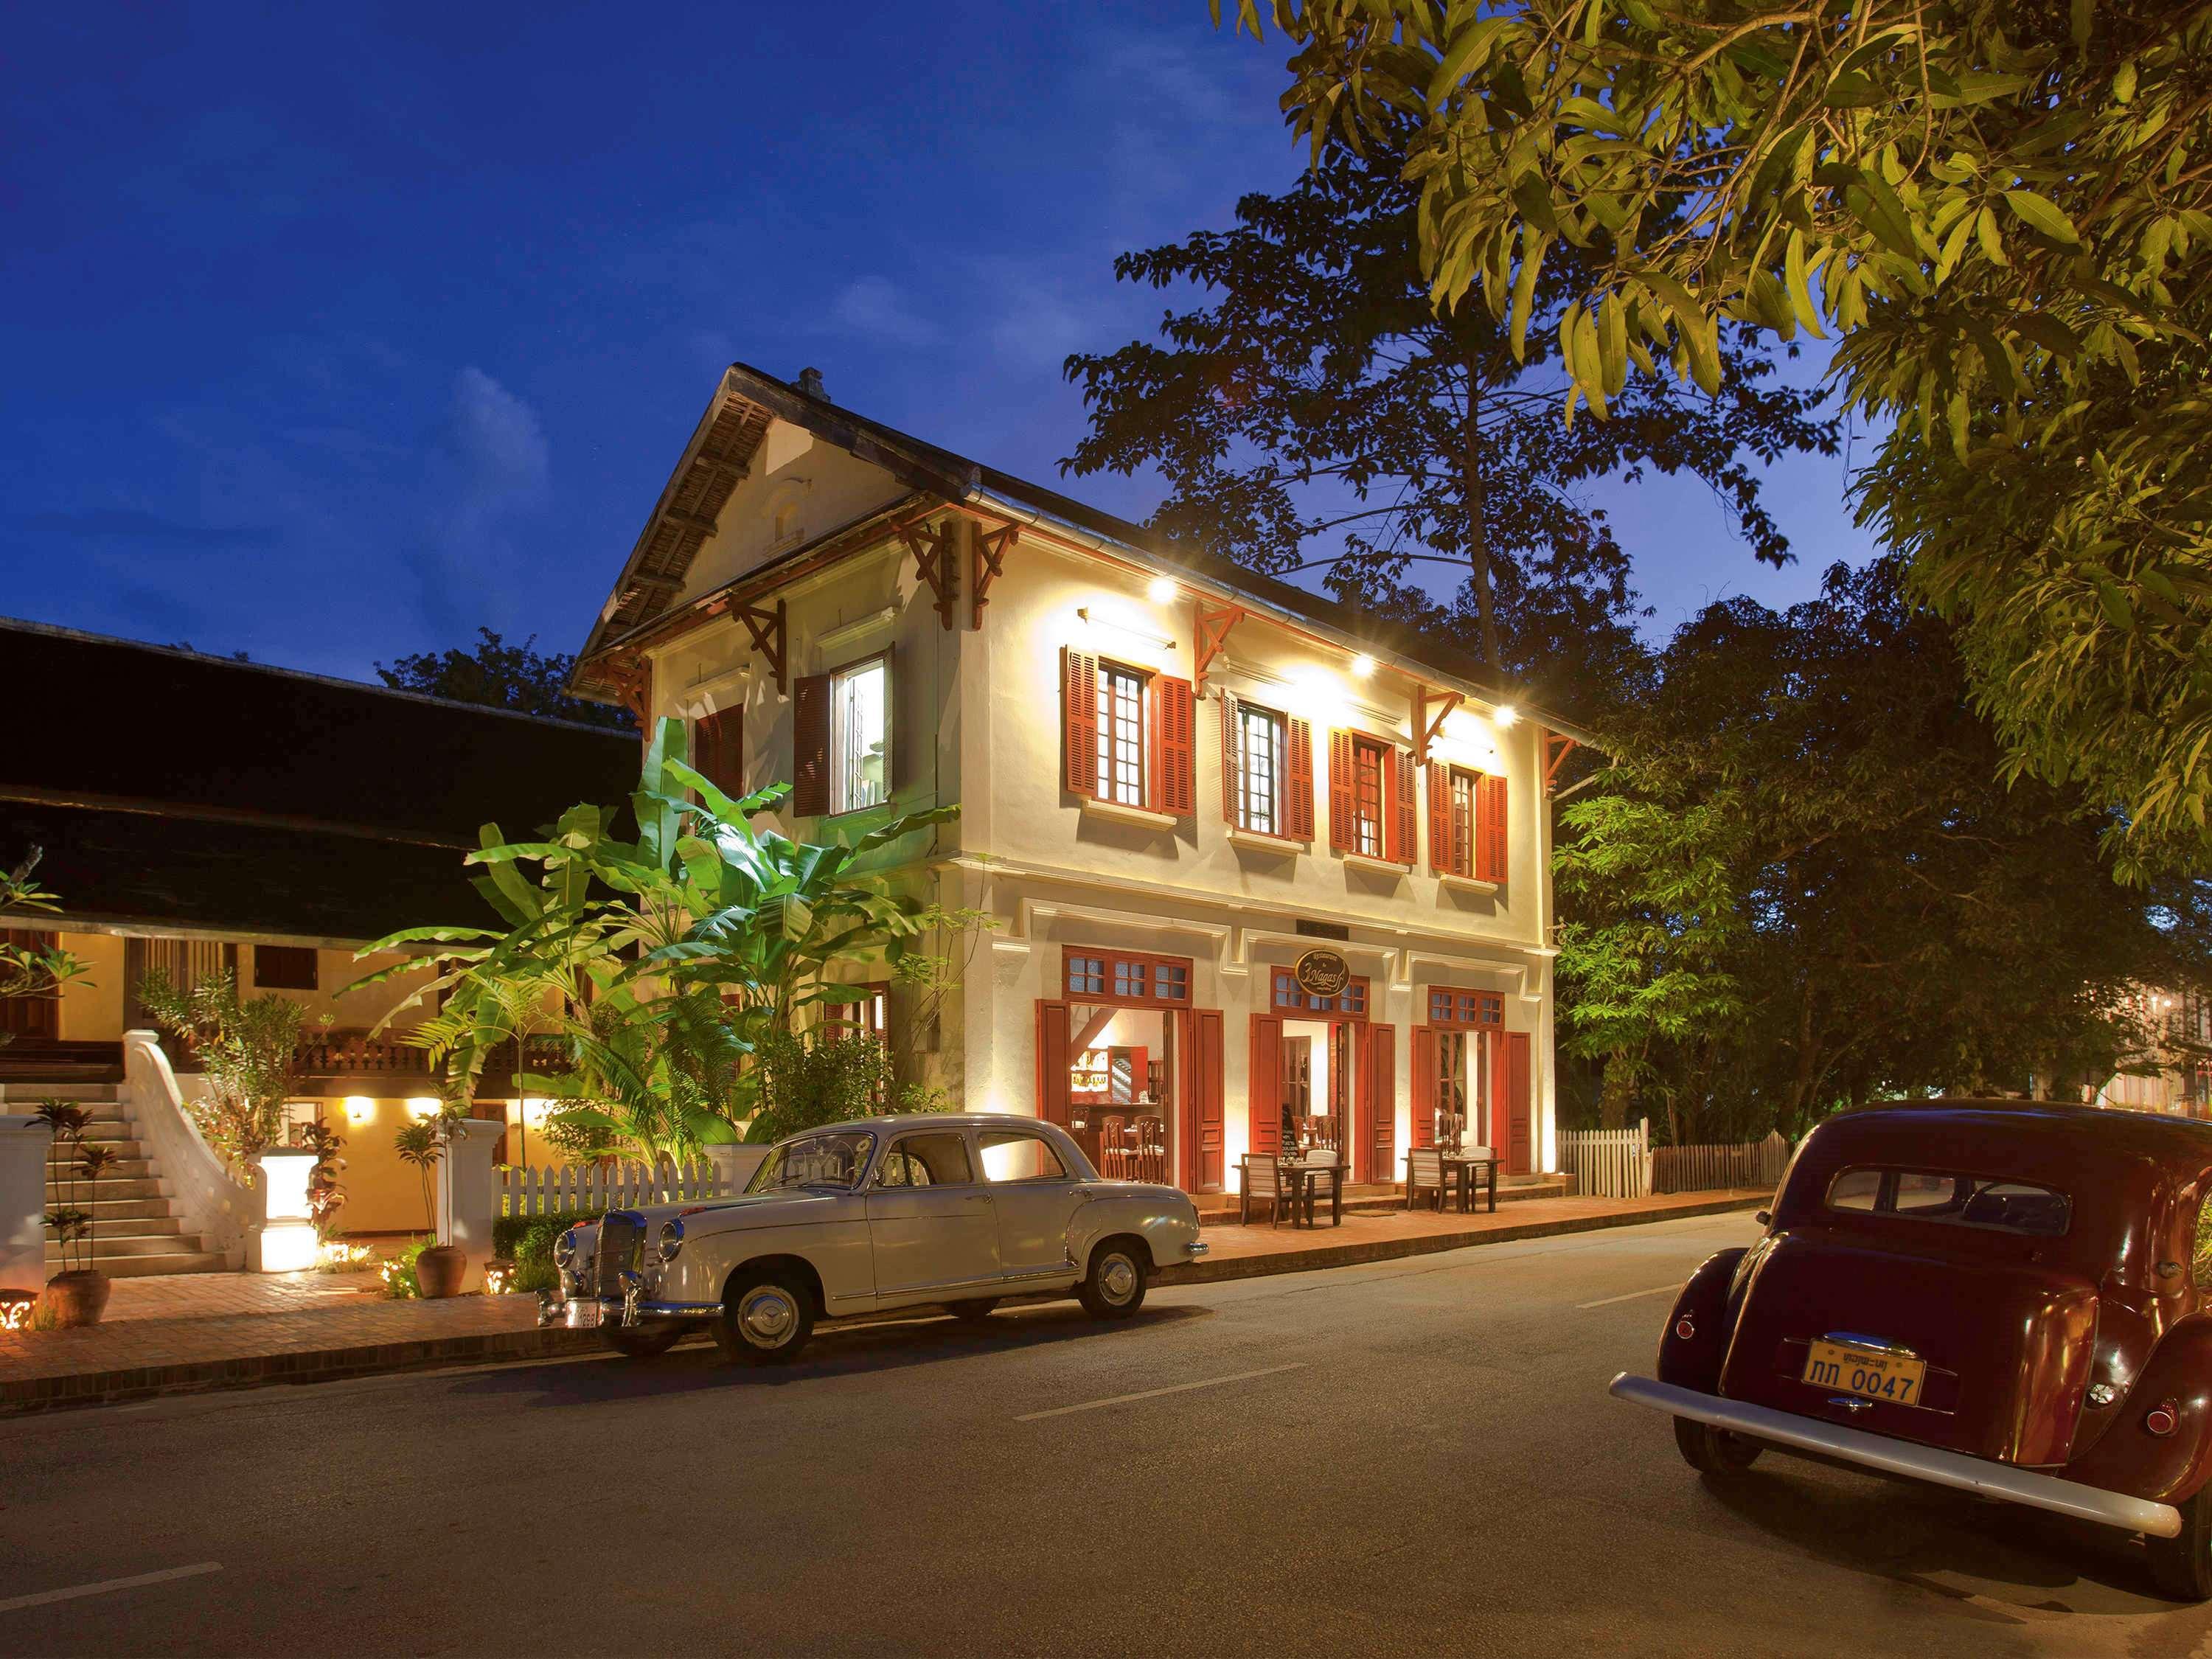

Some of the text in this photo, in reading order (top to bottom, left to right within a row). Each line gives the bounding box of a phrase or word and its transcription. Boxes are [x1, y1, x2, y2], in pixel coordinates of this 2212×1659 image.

[1301, 961, 1338, 986] 3 Nagas
[1851, 1368, 1915, 1400] 0047
